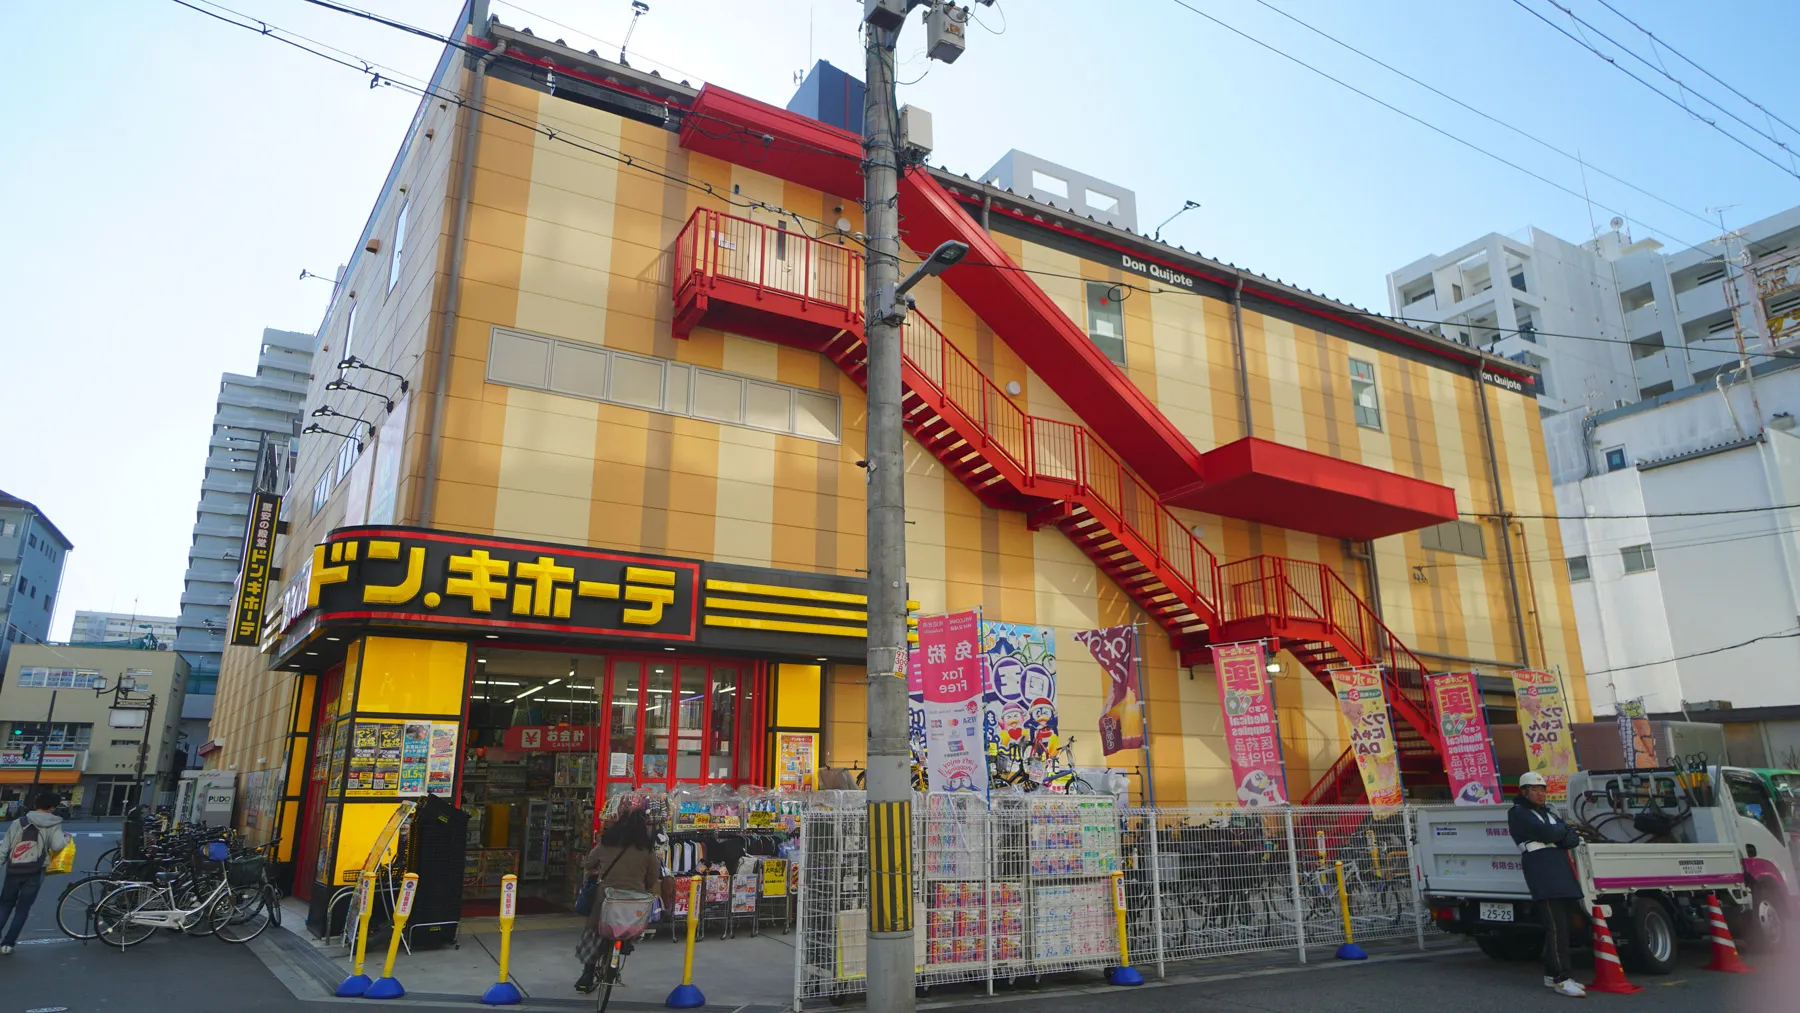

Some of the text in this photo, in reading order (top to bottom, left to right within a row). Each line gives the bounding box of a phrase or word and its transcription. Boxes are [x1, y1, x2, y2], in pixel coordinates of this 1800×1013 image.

[1122, 255, 1193, 287] Don Quijote
[1482, 372, 1521, 390] on Quijote
[547, 730, 584, 742] お会計
[1485, 828, 1511, 836] 情報通
[1491, 861, 1522, 870] 有限会社
[1487, 909, 1512, 920] 25-25
